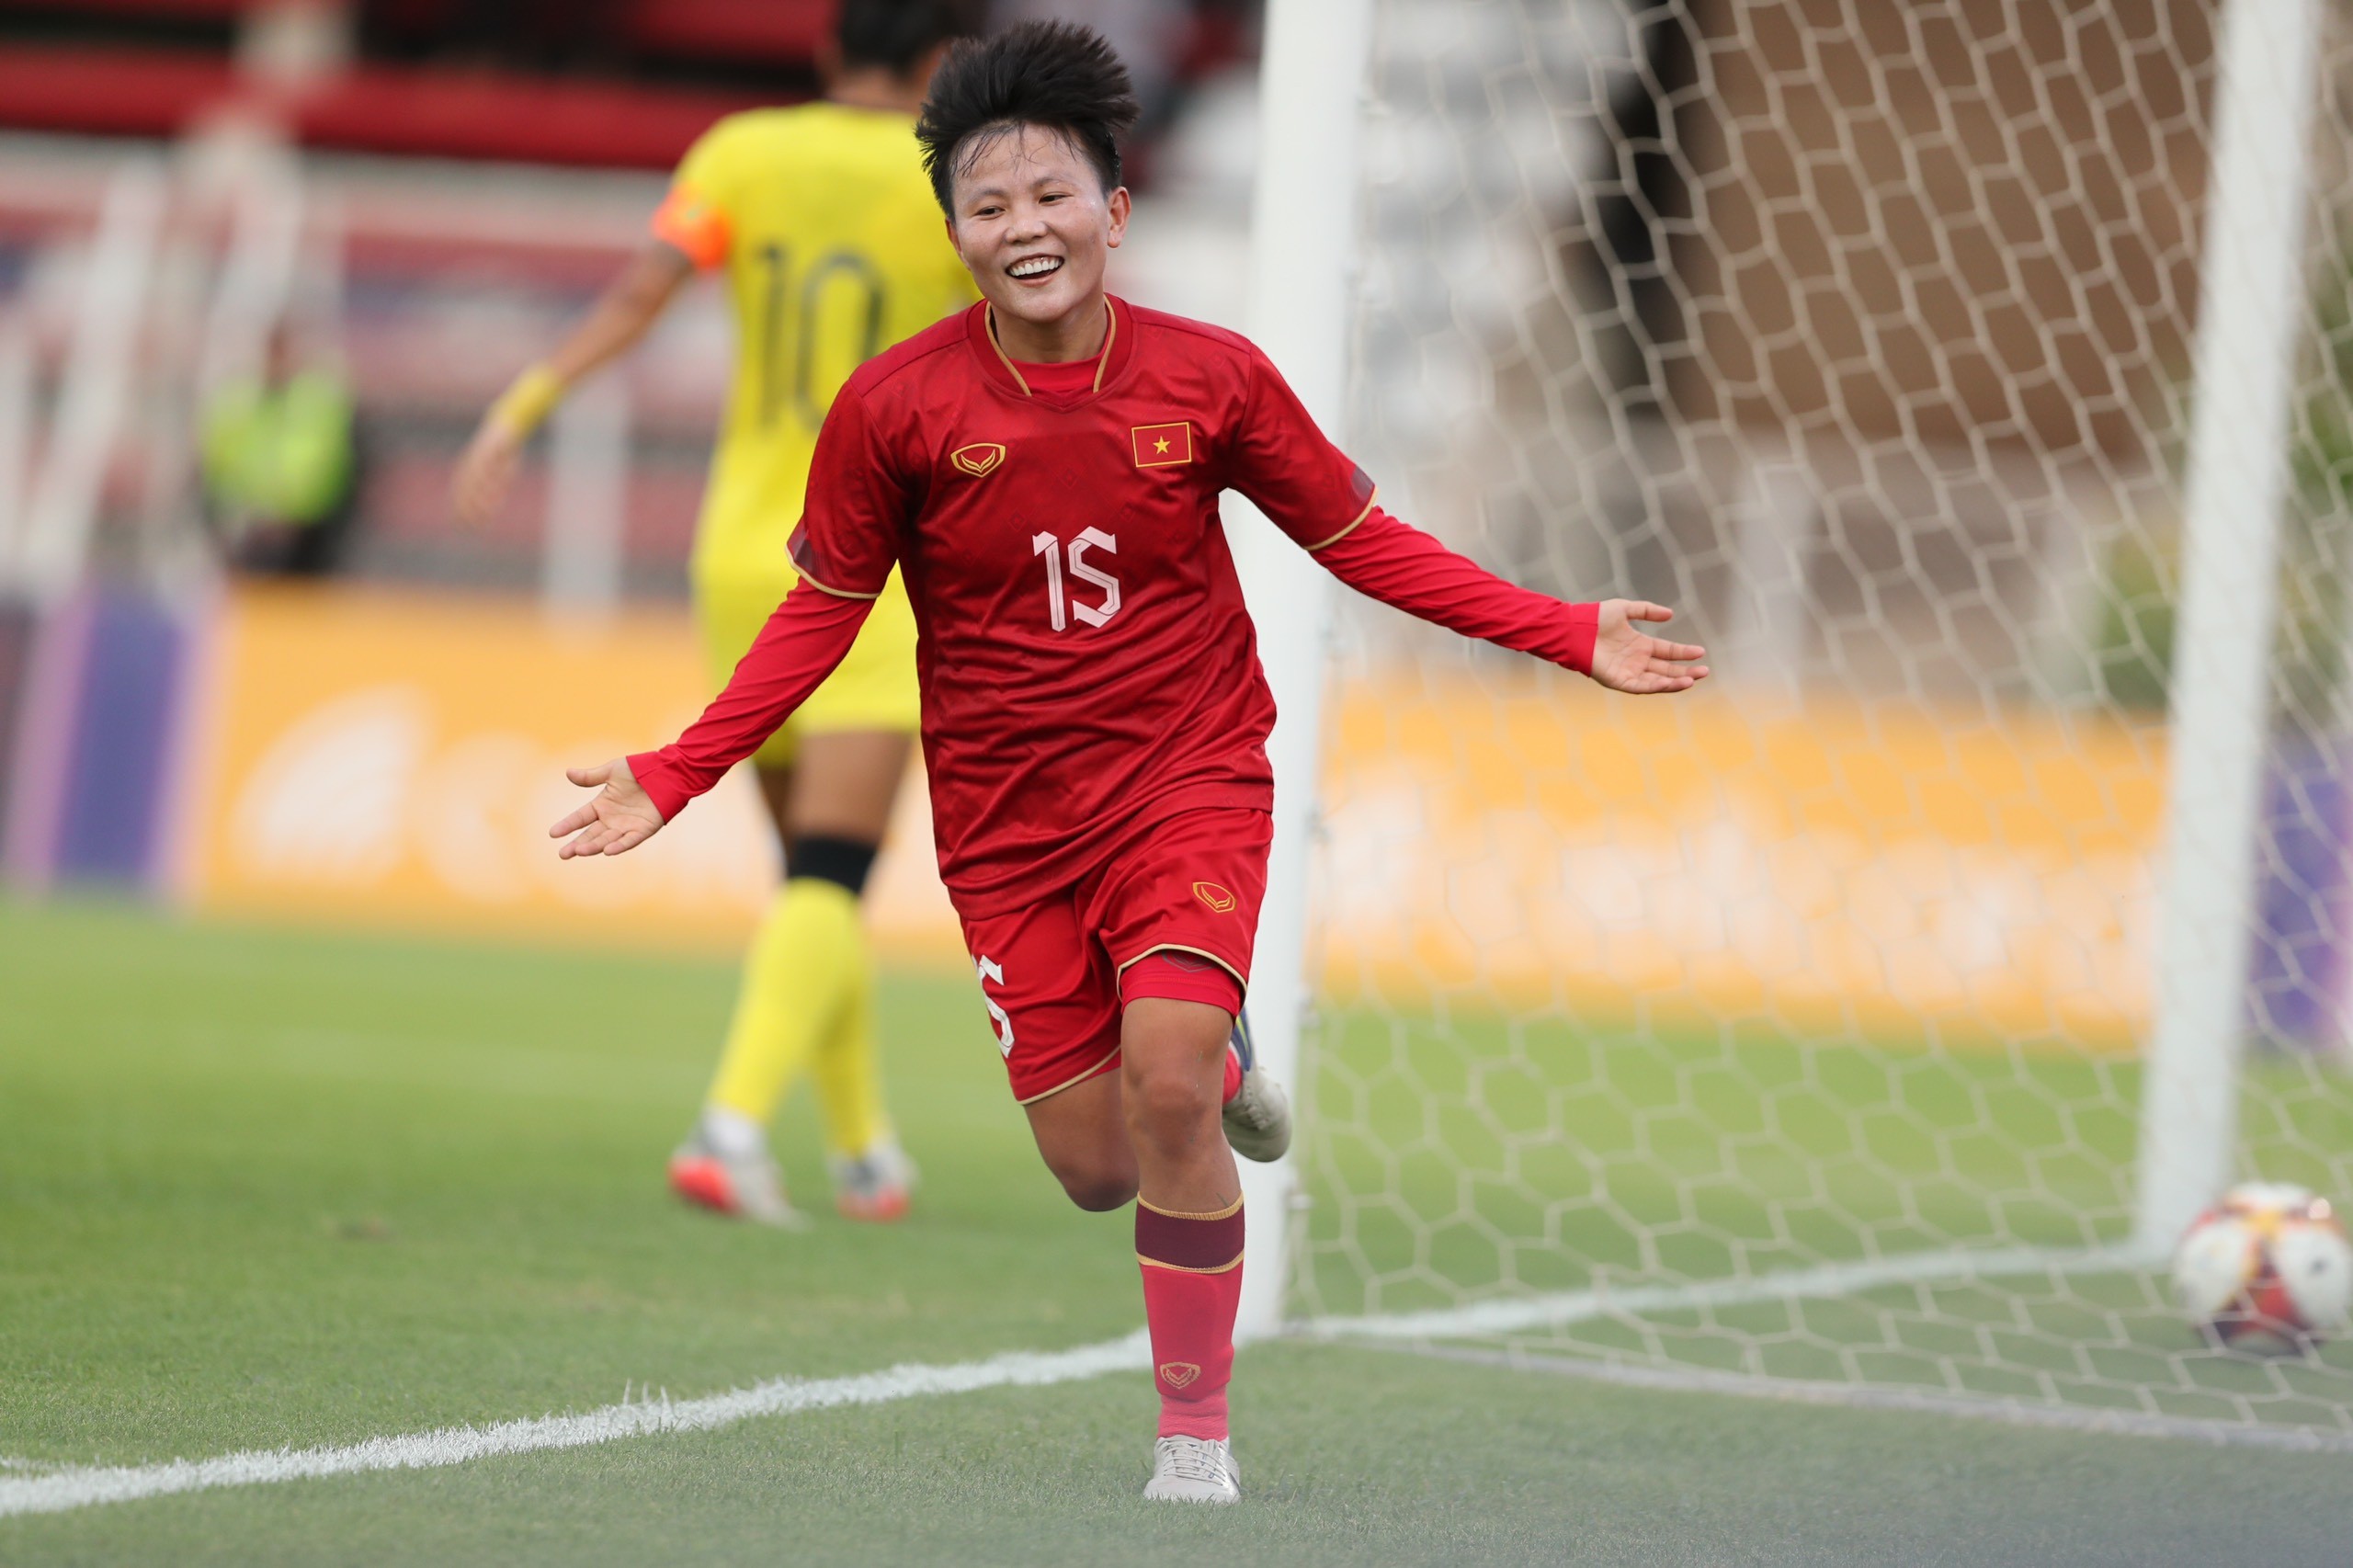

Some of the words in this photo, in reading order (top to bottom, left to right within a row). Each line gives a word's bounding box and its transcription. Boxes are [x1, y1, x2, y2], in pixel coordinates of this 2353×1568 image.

[752, 239, 891, 434] 10
[1031, 525, 1121, 632] 15
[971, 954, 1016, 1059] 5
